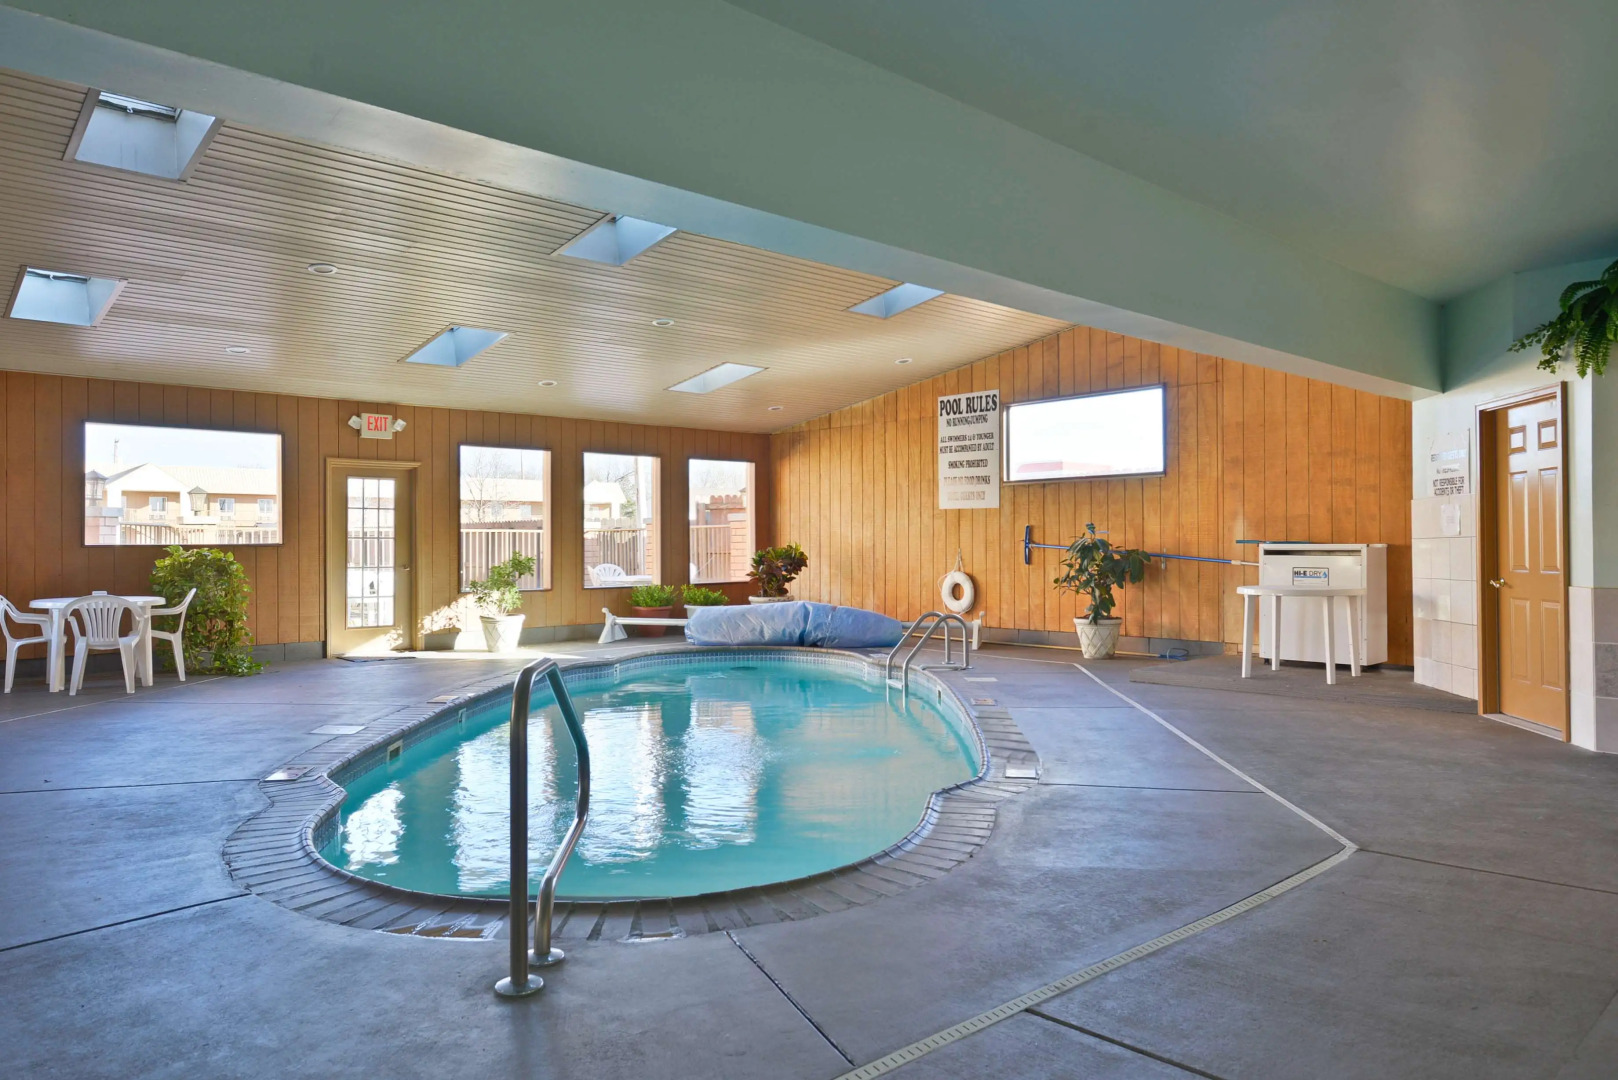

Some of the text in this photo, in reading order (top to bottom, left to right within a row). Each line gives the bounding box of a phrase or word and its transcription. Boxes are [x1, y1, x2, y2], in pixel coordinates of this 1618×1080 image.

[940, 394, 997, 416] POOL RULES
[367, 415, 389, 431] EXIT
[947, 418, 951, 427] NO
[977, 432, 994, 441] YOUNGER
[940, 445, 948, 453] MUST
[949, 445, 953, 453] BE
[983, 442, 994, 451] ADULT
[948, 459, 988, 469] SMOKING PROHIBITED
[1439, 477, 1457, 487] RESPONSIBLE
